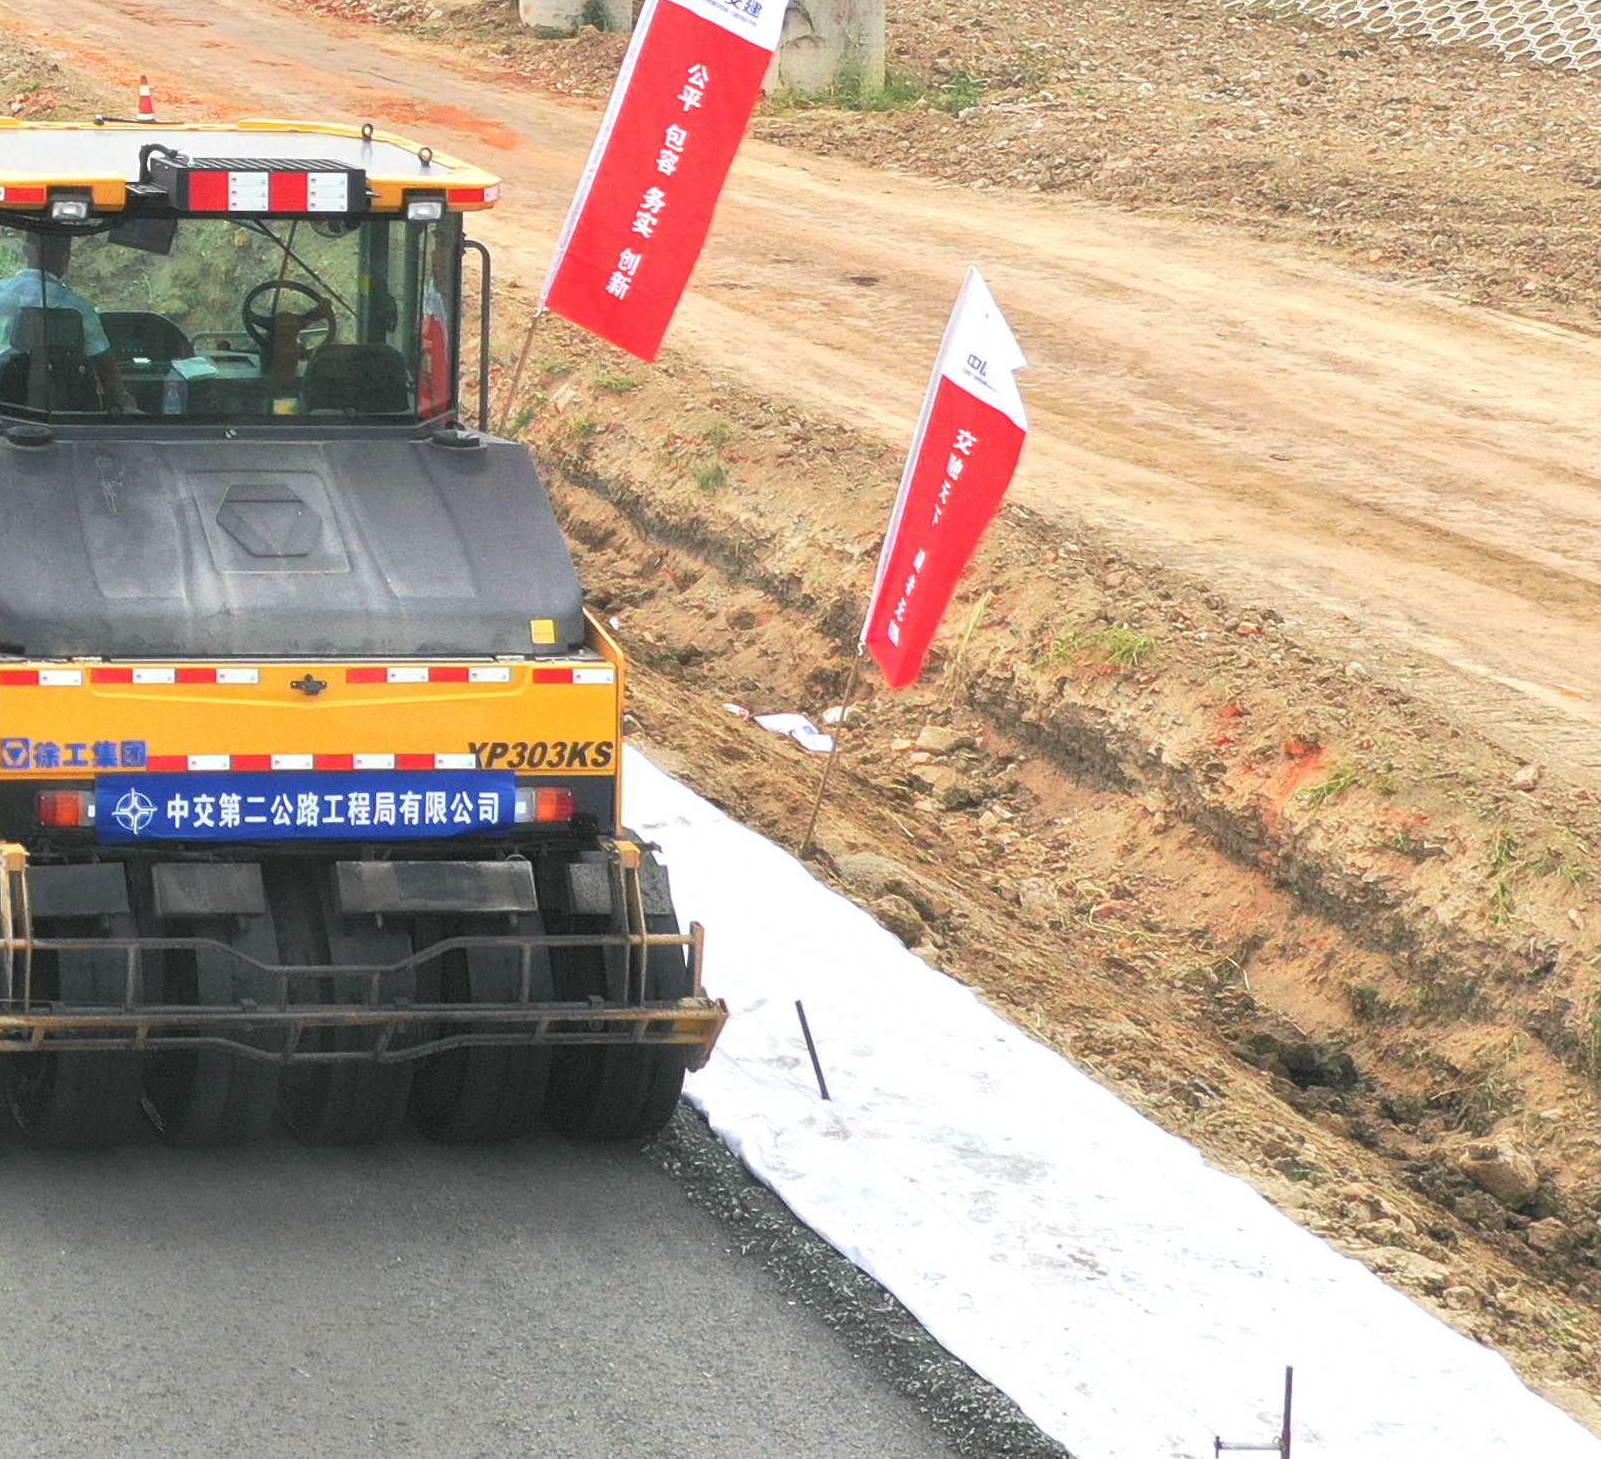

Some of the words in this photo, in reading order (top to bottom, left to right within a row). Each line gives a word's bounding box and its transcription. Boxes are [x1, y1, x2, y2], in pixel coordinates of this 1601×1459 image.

[677, 63, 708, 112] 公平
[656, 124, 687, 176] 包容
[632, 186, 666, 239] 务实
[606, 247, 641, 300] 创新
[34, 740, 147, 768] 徐工集团
[467, 741, 615, 769] XP303KS
[167, 791, 500, 828] 中交第二公路工程局有限公司
